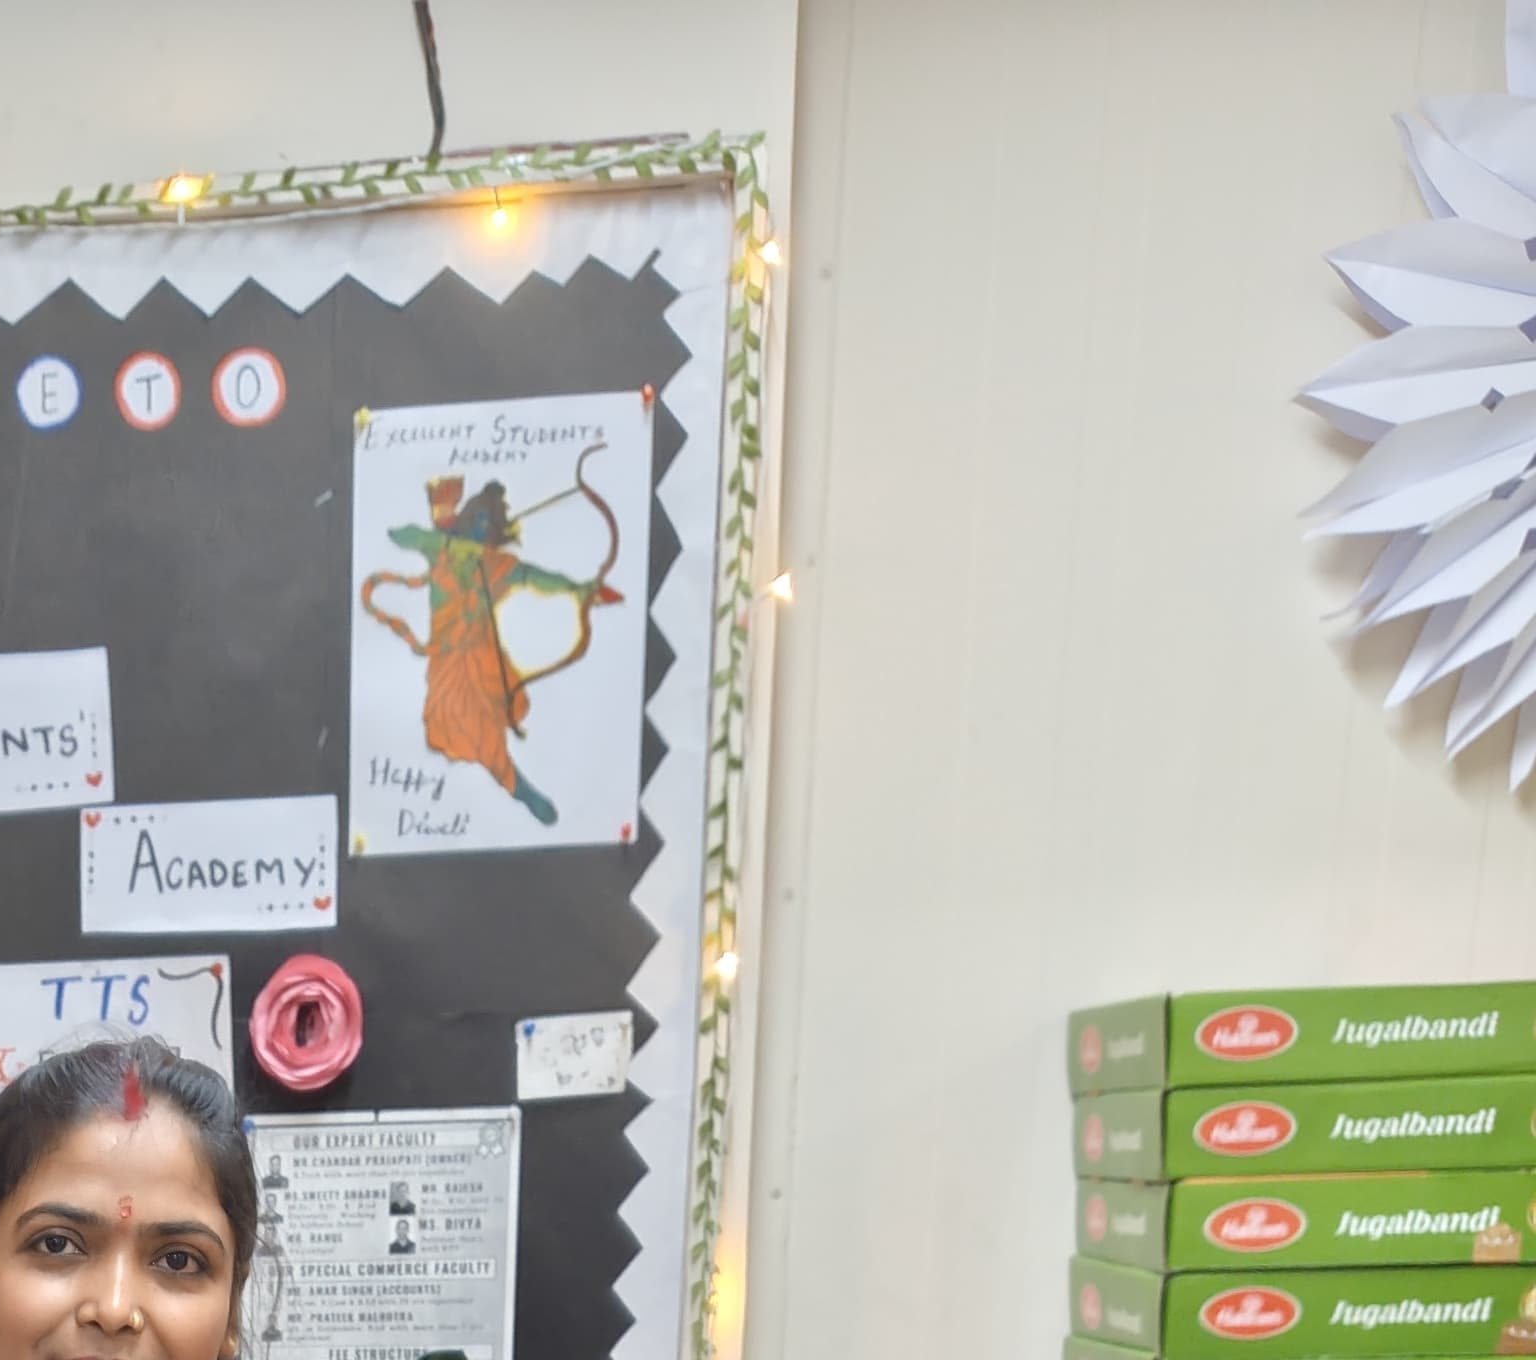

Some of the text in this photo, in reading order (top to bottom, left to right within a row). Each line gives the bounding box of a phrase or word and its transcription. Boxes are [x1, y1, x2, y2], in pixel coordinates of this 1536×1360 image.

[132, 360, 262, 417] TO
[397, 807, 472, 838] Diwali
[41, 972, 152, 1026] TTS
[1331, 1010, 1499, 1049] Jugalbandi
[325, 1133, 374, 1149] EXPERT
[378, 1131, 437, 1148] FACULTY
[1328, 1106, 1497, 1144] Jugalbandi
[1334, 1205, 1501, 1241] Jugalbandi
[299, 1262, 354, 1277] SPECIAL
[433, 1260, 491, 1276] FACULTY
[1328, 1296, 1494, 1328] Jugalbandi
